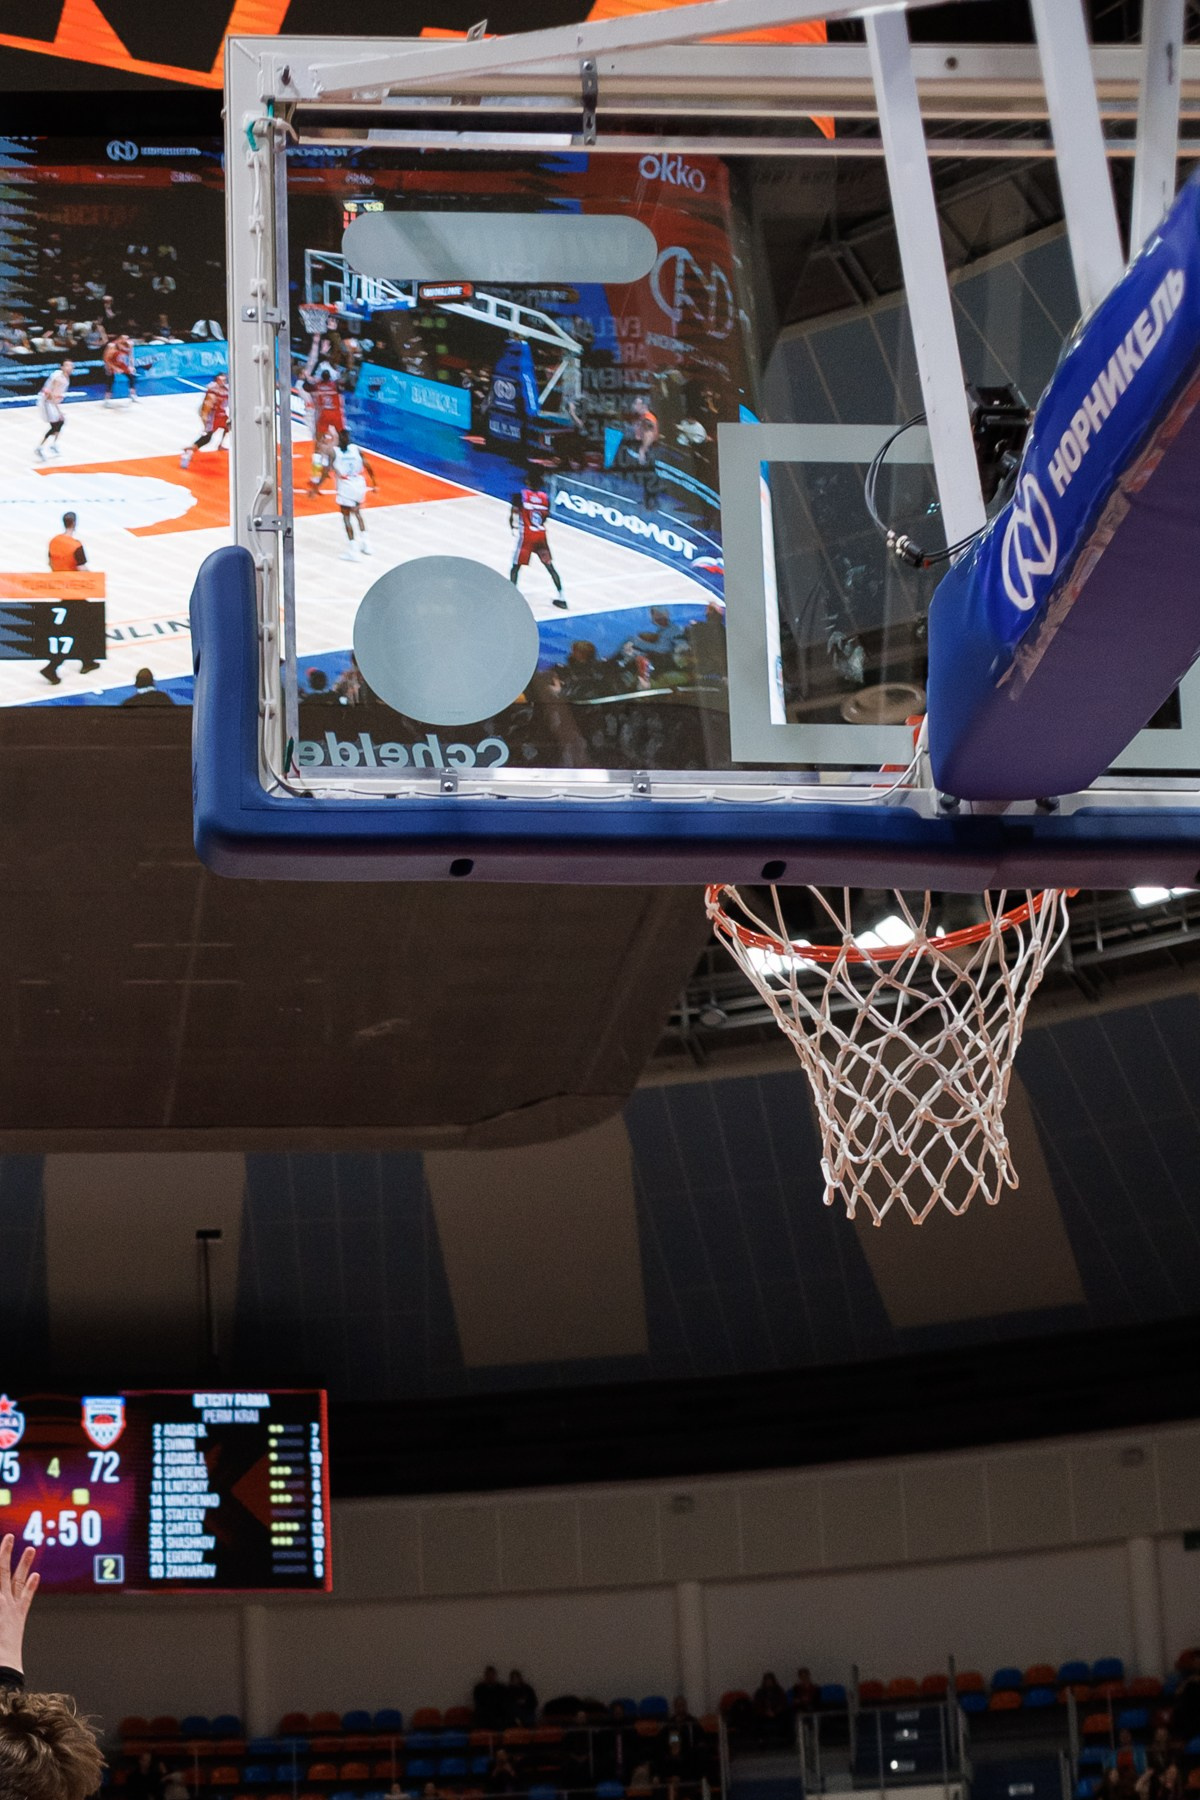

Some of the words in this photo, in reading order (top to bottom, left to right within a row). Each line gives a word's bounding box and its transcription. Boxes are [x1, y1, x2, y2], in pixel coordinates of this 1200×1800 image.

[1048, 268, 1186, 498] НОРНИКЕЛЬ
[554, 490, 699, 560] АЭРОФЛОТ
[51, 607, 68, 626] 7
[48, 636, 74, 655] 17
[310, 1423, 319, 1436] 7
[47, 1458, 60, 1478] 4
[87, 1451, 120, 1483] 72
[23, 1510, 101, 1547] 4:50
[165, 1522, 202, 1535] CARTER
[103, 1558, 116, 1579] 2
[166, 1565, 216, 1578] ZAKHAROV
